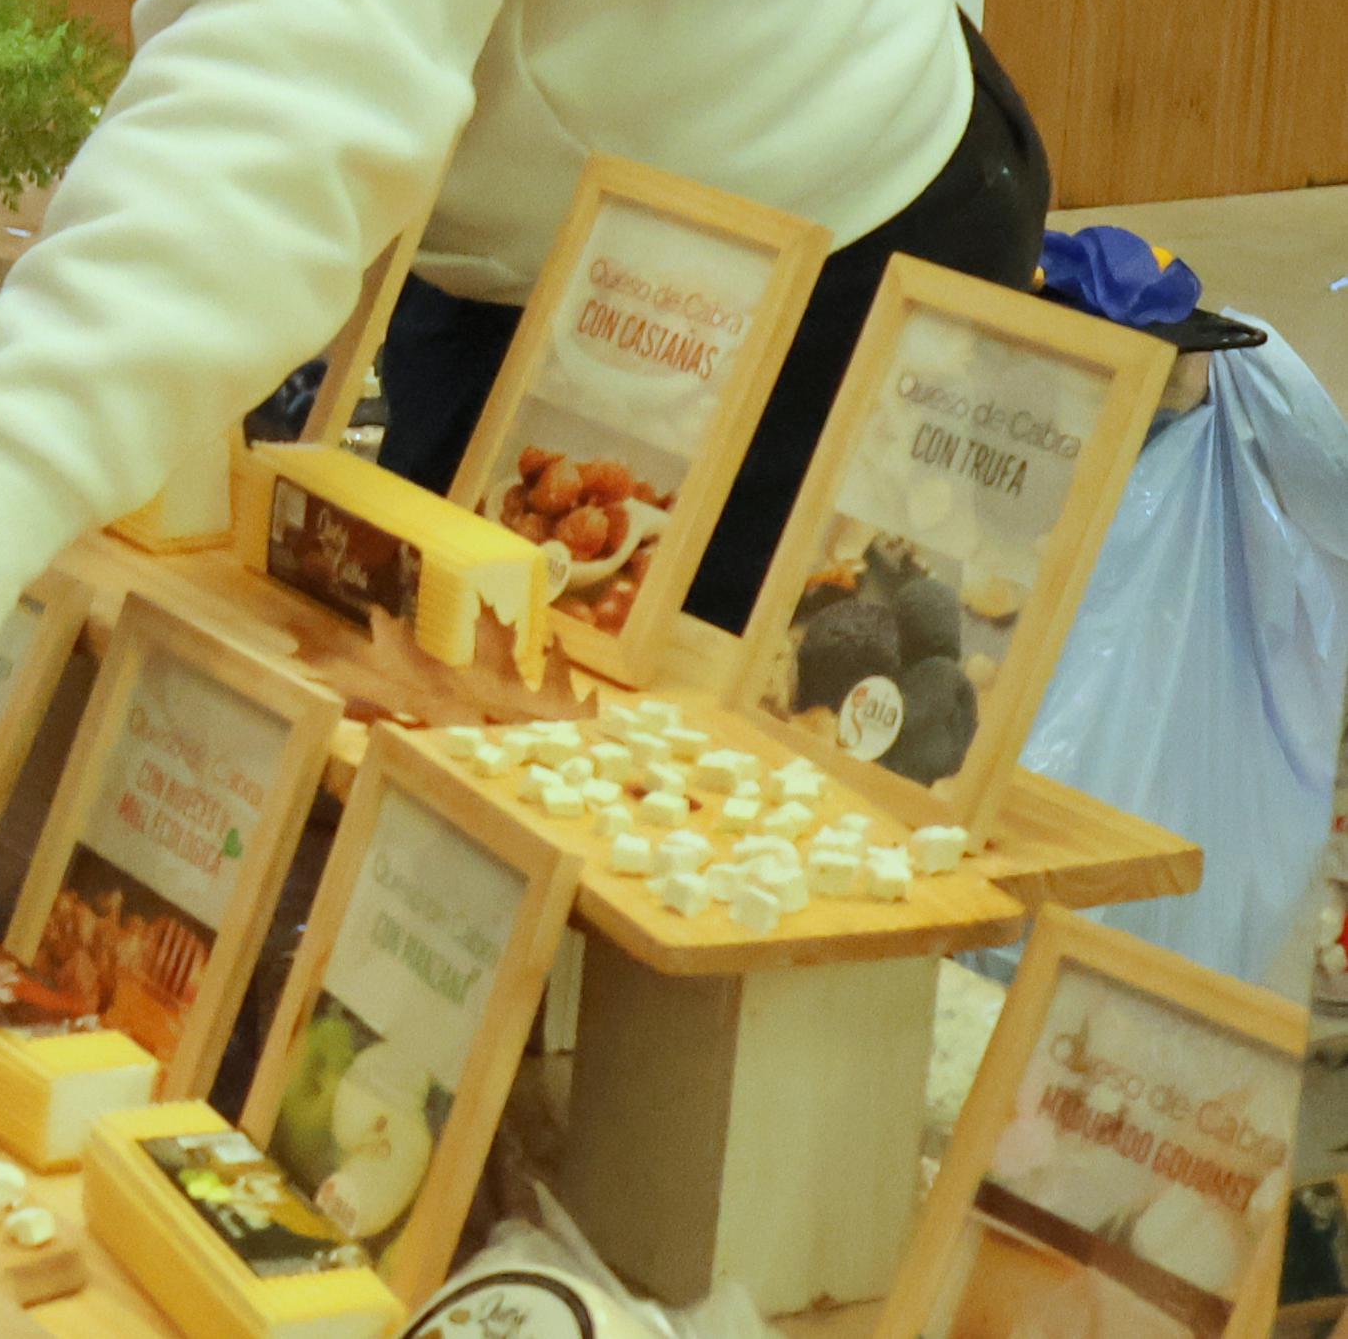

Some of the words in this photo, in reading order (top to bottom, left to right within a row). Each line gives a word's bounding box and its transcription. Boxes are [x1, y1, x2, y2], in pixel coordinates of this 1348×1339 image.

[578, 299, 619, 342] CON
[617, 314, 719, 380] CASTAÑAS
[897, 372, 970, 417] Queso
[1007, 411, 1082, 459] Cabra
[911, 423, 961, 470] CON
[958, 439, 1028, 497] TRUFA
